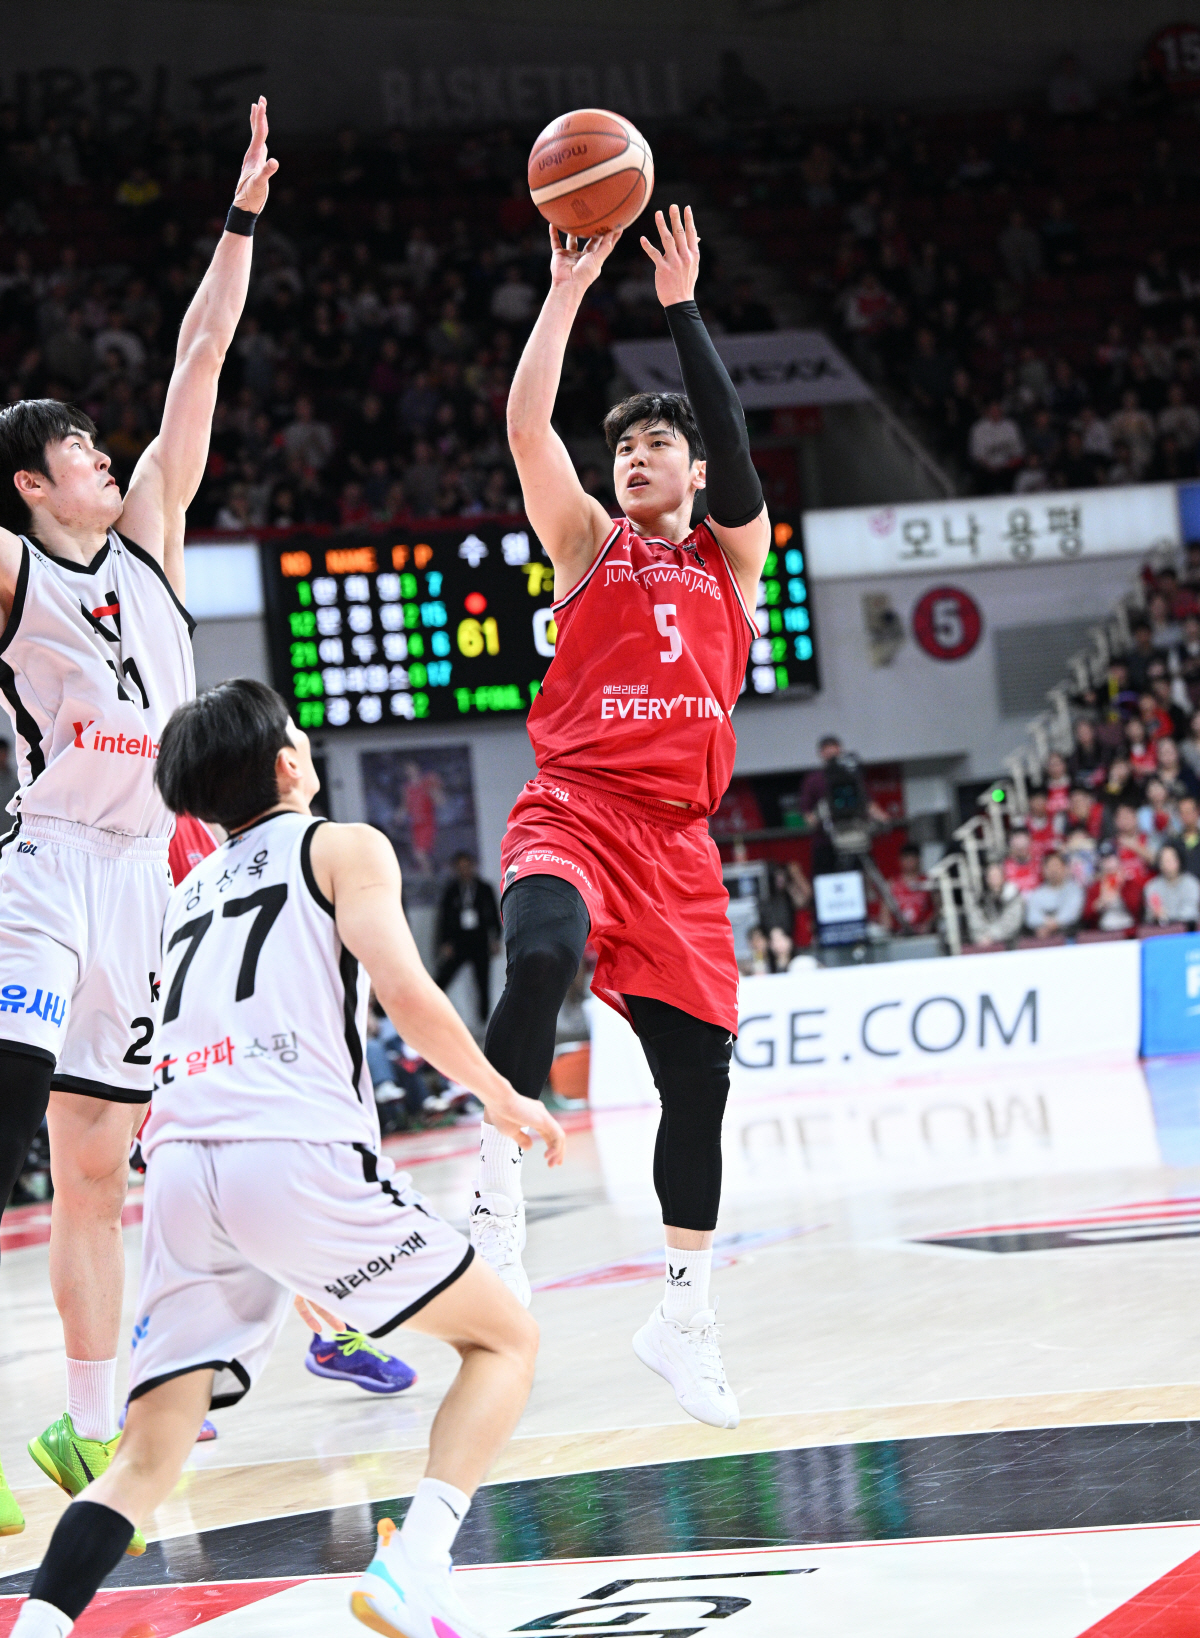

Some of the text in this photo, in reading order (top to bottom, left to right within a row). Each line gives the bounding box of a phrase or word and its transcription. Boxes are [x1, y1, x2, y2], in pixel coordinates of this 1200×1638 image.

[457, 617, 500, 658] 61
[653, 604, 683, 663] 5
[930, 600, 965, 649] 5
[603, 684, 649, 695] 에브리타임
[162, 883, 288, 1026] 77
[0, 984, 66, 1028] 유사나
[186, 1036, 235, 1076] 알파
